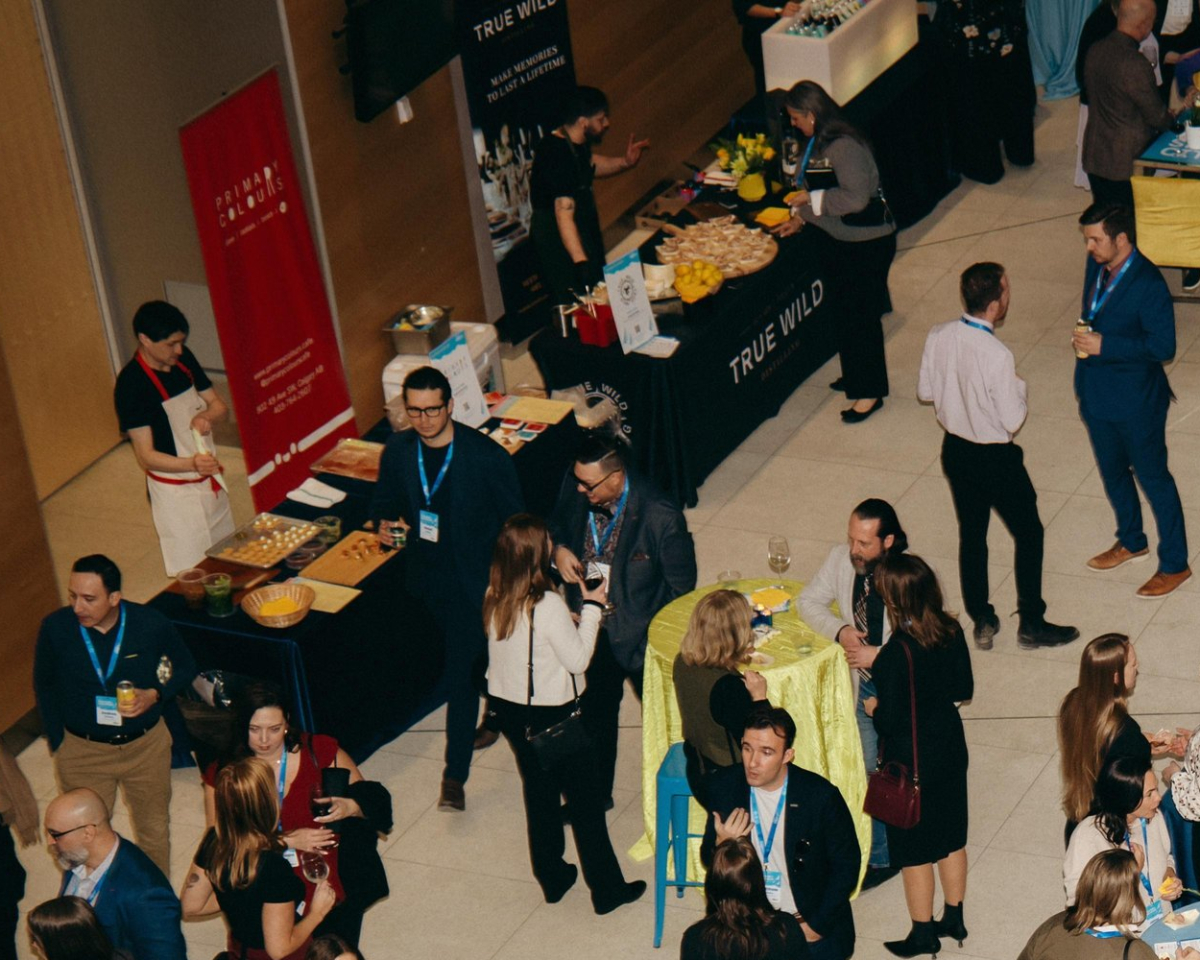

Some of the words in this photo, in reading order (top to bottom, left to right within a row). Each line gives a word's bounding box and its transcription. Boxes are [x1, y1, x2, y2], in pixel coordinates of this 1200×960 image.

[473, 8, 515, 42] TRUE
[486, 90, 499, 103] TO
[499, 78, 518, 97] LAST
[526, 54, 566, 82] LIFETIME
[513, 45, 558, 73] MEMORIES
[219, 176, 283, 228] COLOURS
[729, 322, 777, 384] TRUE
[779, 279, 824, 336] WILD
[601, 383, 628, 411] WILD
